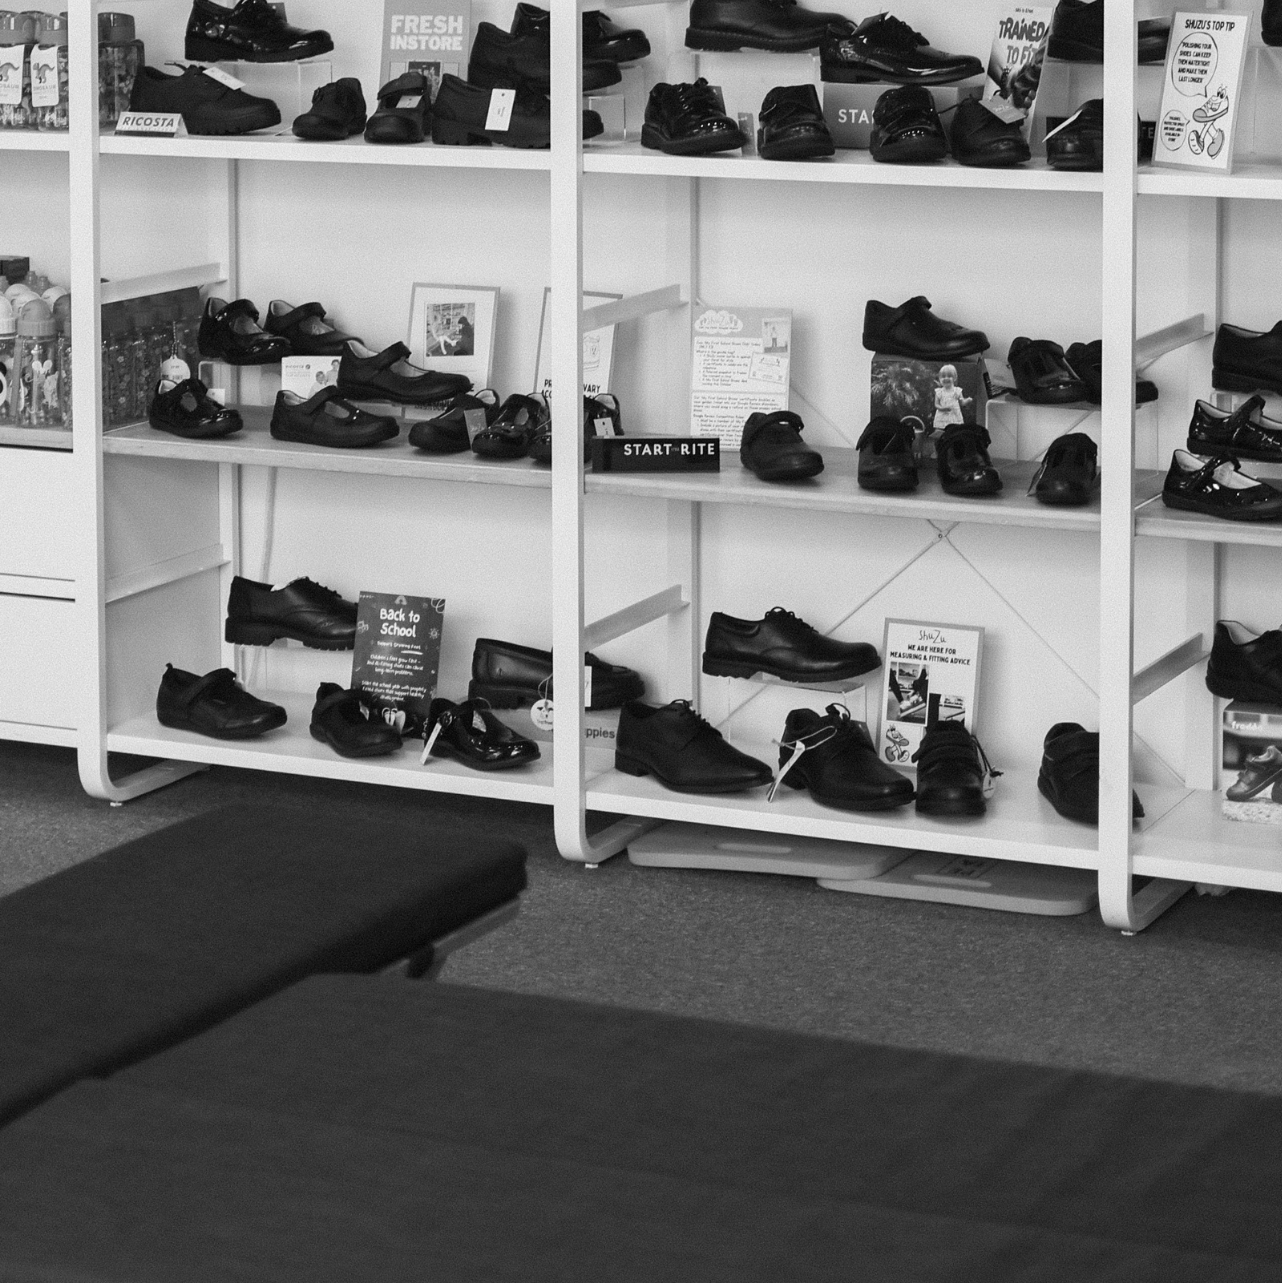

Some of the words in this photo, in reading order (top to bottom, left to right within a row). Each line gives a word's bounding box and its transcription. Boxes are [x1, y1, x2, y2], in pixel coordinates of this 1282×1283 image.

[390, 14, 464, 34] FRESH
[1184, 19, 1211, 30] SHUZU'S
[1212, 21, 1224, 31] TOP
[1225, 22, 1236, 31] TIP
[389, 35, 464, 51] INSTORE
[1007, 45, 1020, 65] TO
[122, 116, 174, 128] RICOSTA
[624, 443, 672, 456] START
[681, 443, 715, 456] RITE
[380, 608, 405, 622] Back
[408, 610, 420, 623] to
[380, 622, 416, 638] School
[929, 646, 944, 654] HERE
[890, 651, 922, 661] MEASURING
[928, 656, 949, 664] FITTING
[950, 657, 971, 666] ADVICE
[585, 727, 616, 739] ppies
